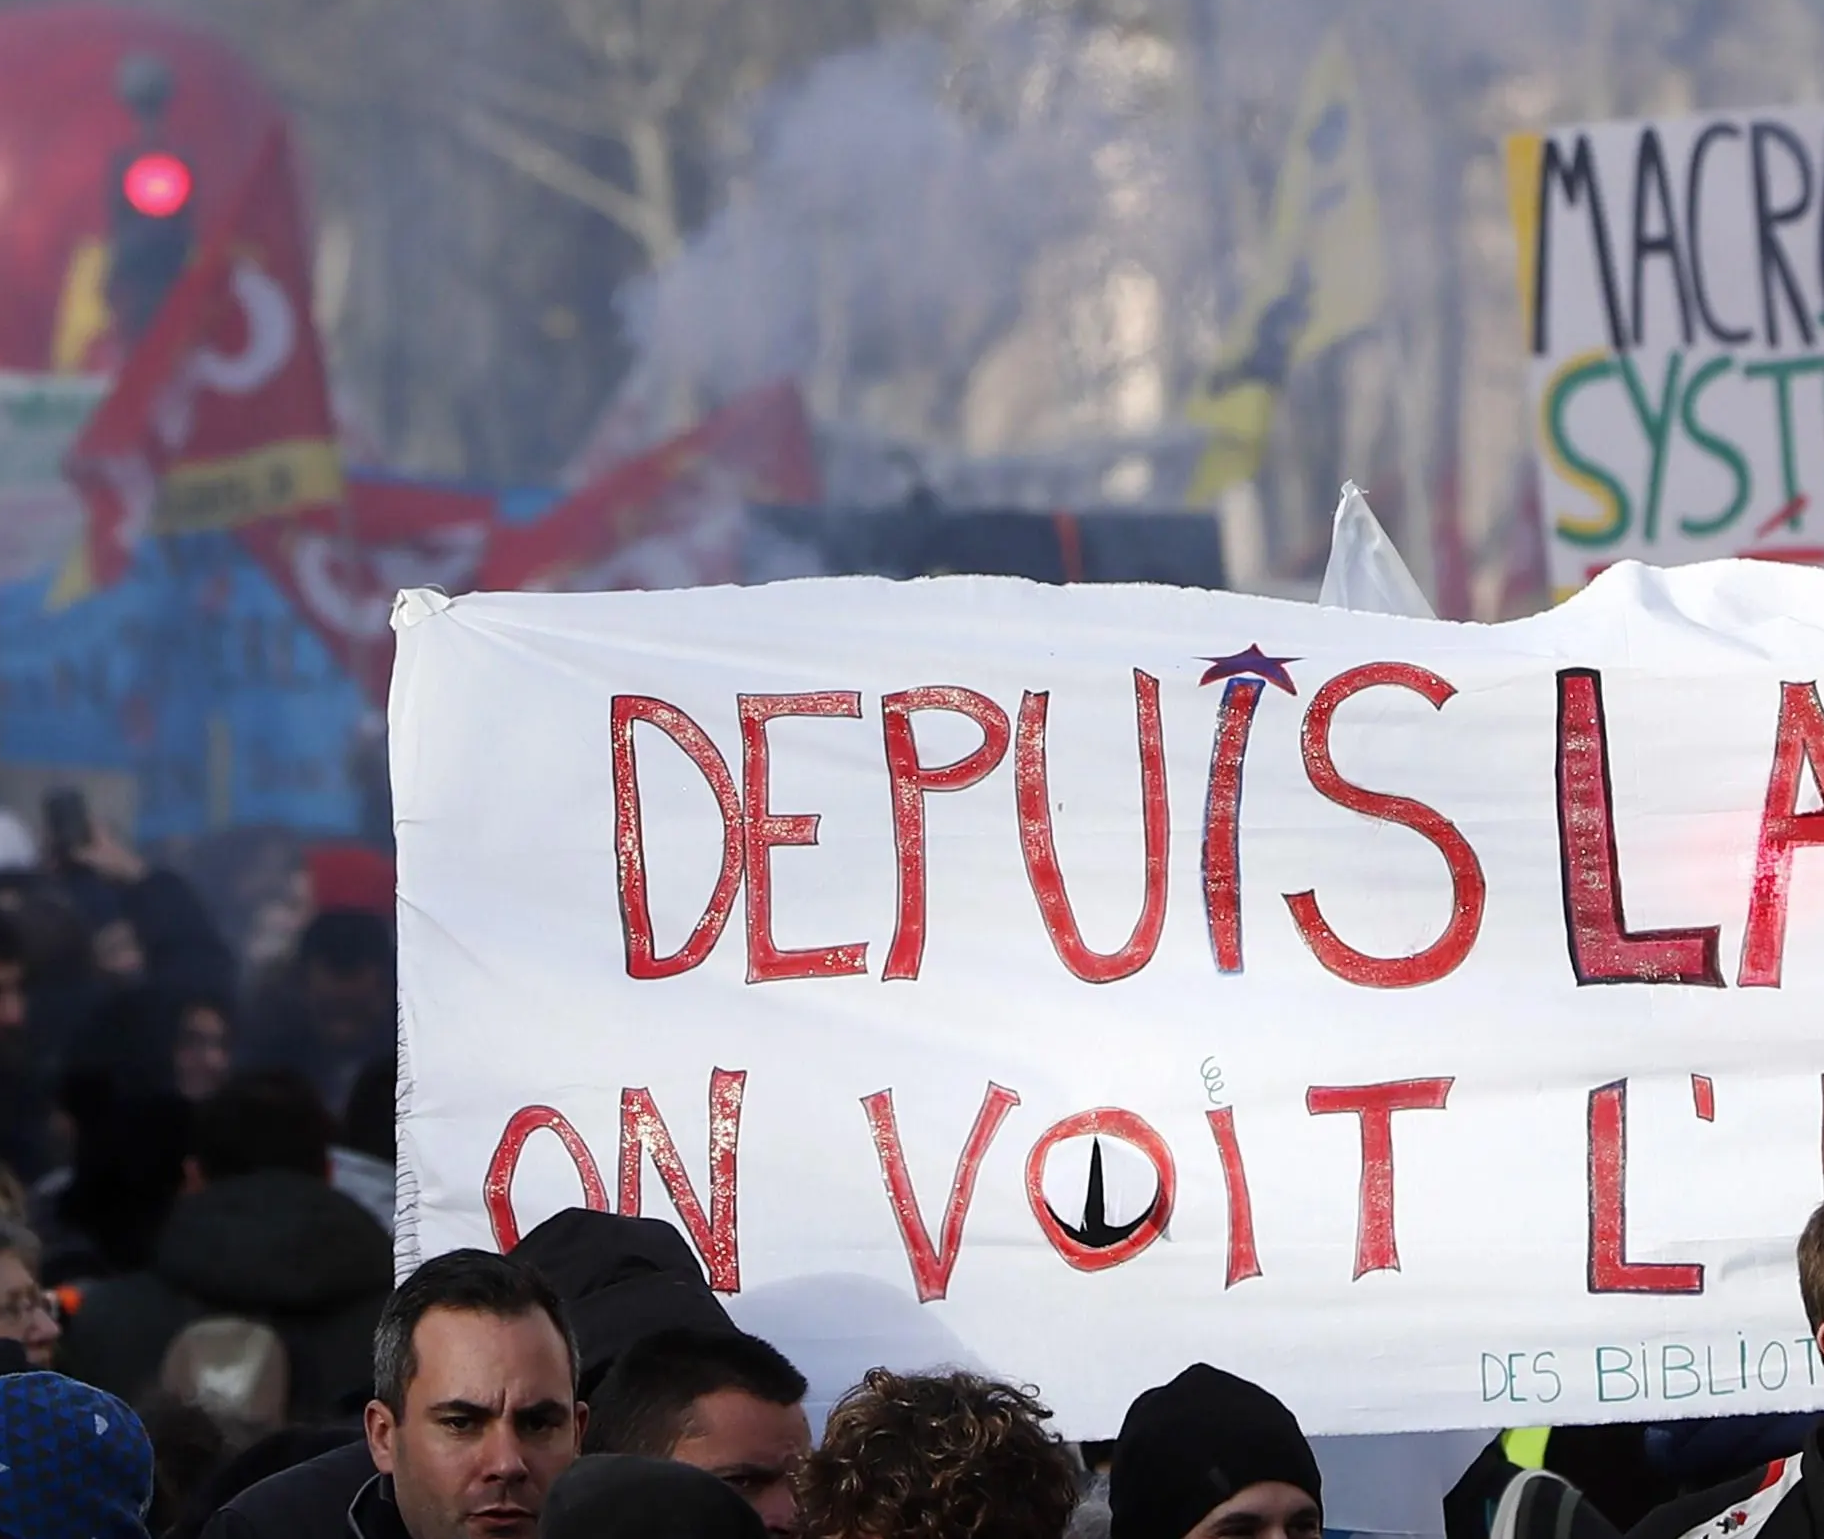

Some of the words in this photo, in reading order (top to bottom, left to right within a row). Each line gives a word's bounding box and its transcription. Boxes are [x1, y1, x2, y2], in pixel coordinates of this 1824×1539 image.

[610, 644, 1488, 990] DEPUIS
[483, 1065, 748, 1294] ON
[859, 1055, 1456, 1304] VOIT
[1480, 1347, 1562, 1403] DES
